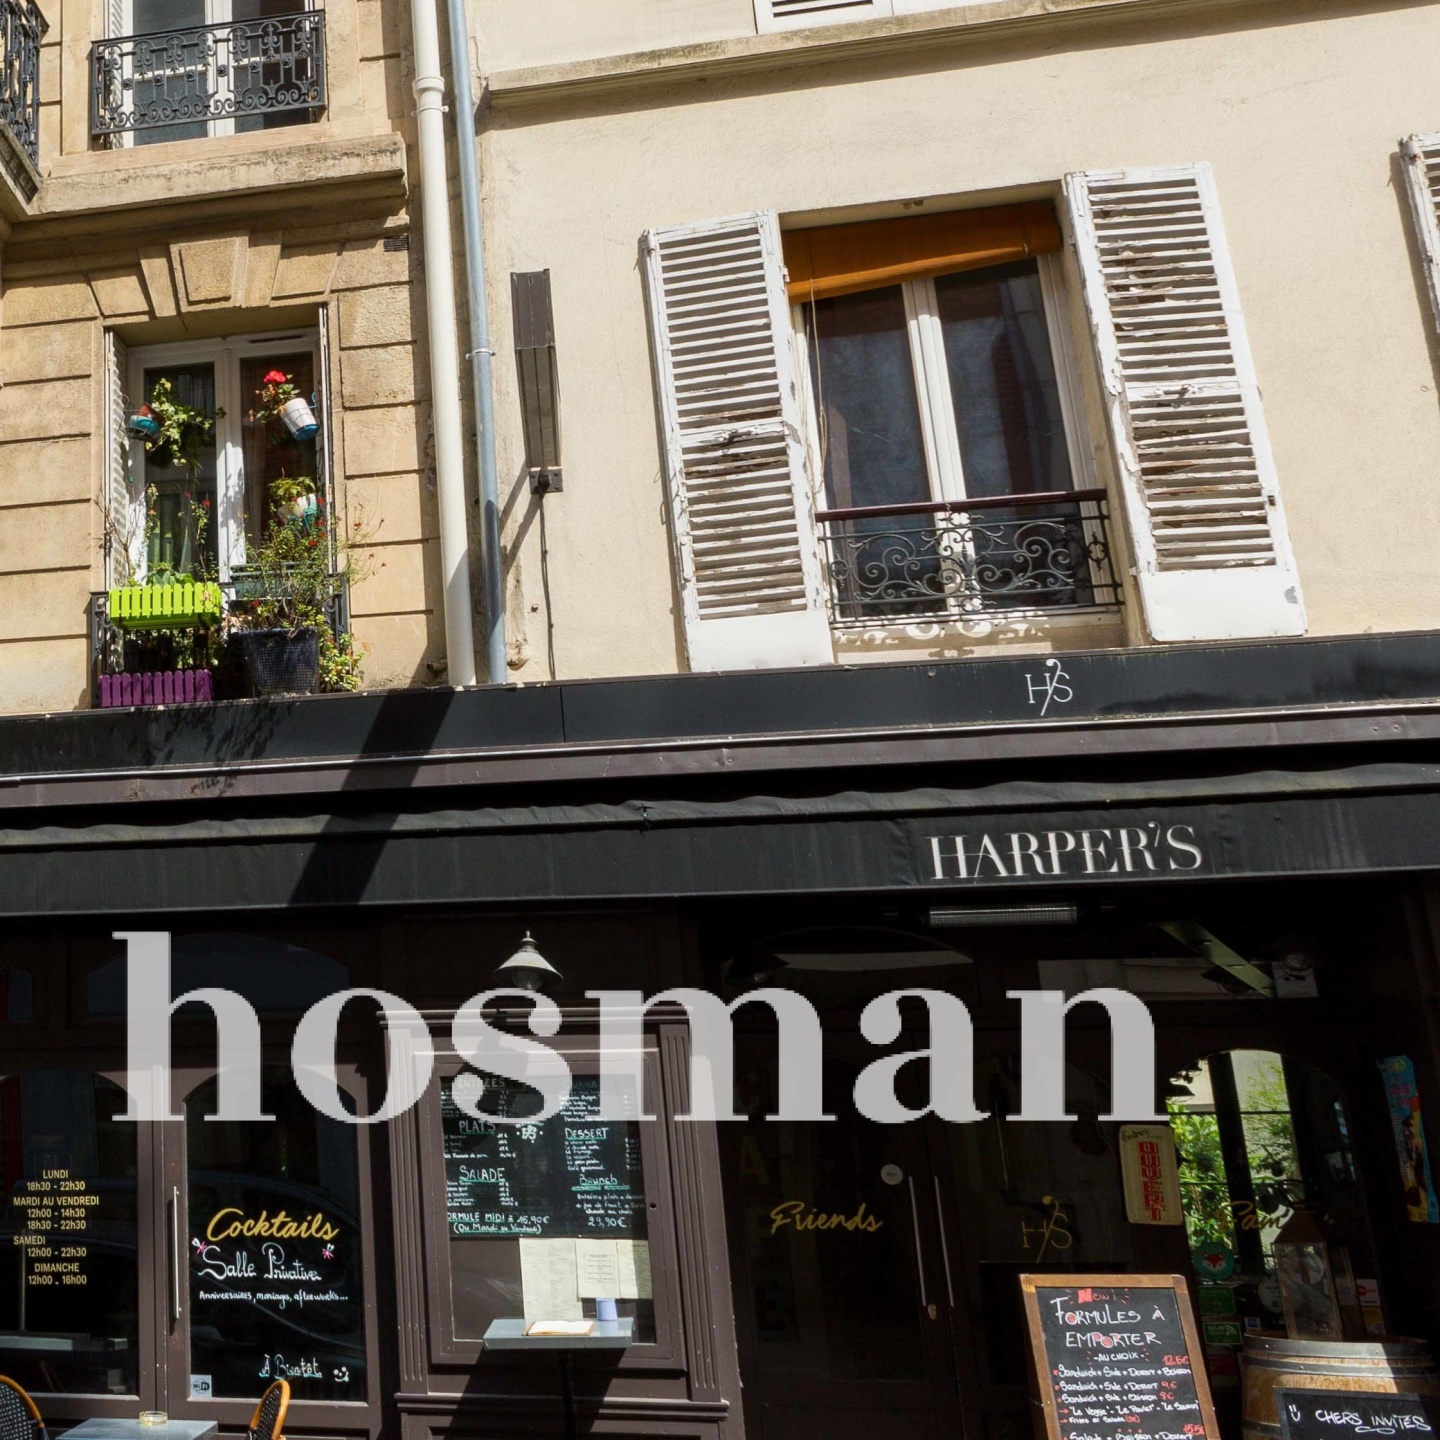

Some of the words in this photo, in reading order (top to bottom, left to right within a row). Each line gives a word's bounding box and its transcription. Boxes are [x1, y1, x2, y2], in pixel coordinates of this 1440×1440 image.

[926, 821, 1203, 884] HARPER'S
[459, 1120, 496, 1133] PLATS
[565, 1127, 609, 1139] DESSERT
[43, 1169, 69, 1179] LUNDI
[459, 1165, 505, 1181] SALADE
[27, 1181, 51, 1191] 18h30
[60, 1181, 86, 1191] 22h30
[13, 1196, 40, 1206] MARDI
[42, 1196, 55, 1206] AU
[56, 1195, 100, 1206] VENDREDI
[27, 1208, 52, 1218] 12h00
[61, 1208, 86, 1218] 14h30
[447, 1212, 480, 1221] ORMULE
[770, 1201, 883, 1235] Friends
[27, 1220, 52, 1230] 18h30
[60, 1220, 86, 1230] 22h30
[206, 1208, 340, 1242] Cocktails
[13, 1235, 46, 1245] SAMEDI
[27, 1247, 52, 1257] 12h00
[61, 1247, 87, 1257] 22h30
[34, 1263, 80, 1272] DIMANCHE
[197, 1245, 257, 1280] Salle
[262, 1242, 322, 1281] Privative
[28, 1275, 53, 1285] 12h00
[62, 1275, 87, 1285] 16h00
[1050, 1297, 1141, 1325] FORMULES
[1152, 1305, 1165, 1321] À
[1066, 1331, 1162, 1348] EMPORTER
[1058, 1364, 1097, 1378] Sandwich
[1060, 1380, 1098, 1392] Sandwich
[1061, 1393, 1098, 1403] Sandwich
[1315, 1410, 1362, 1426] CHERS
